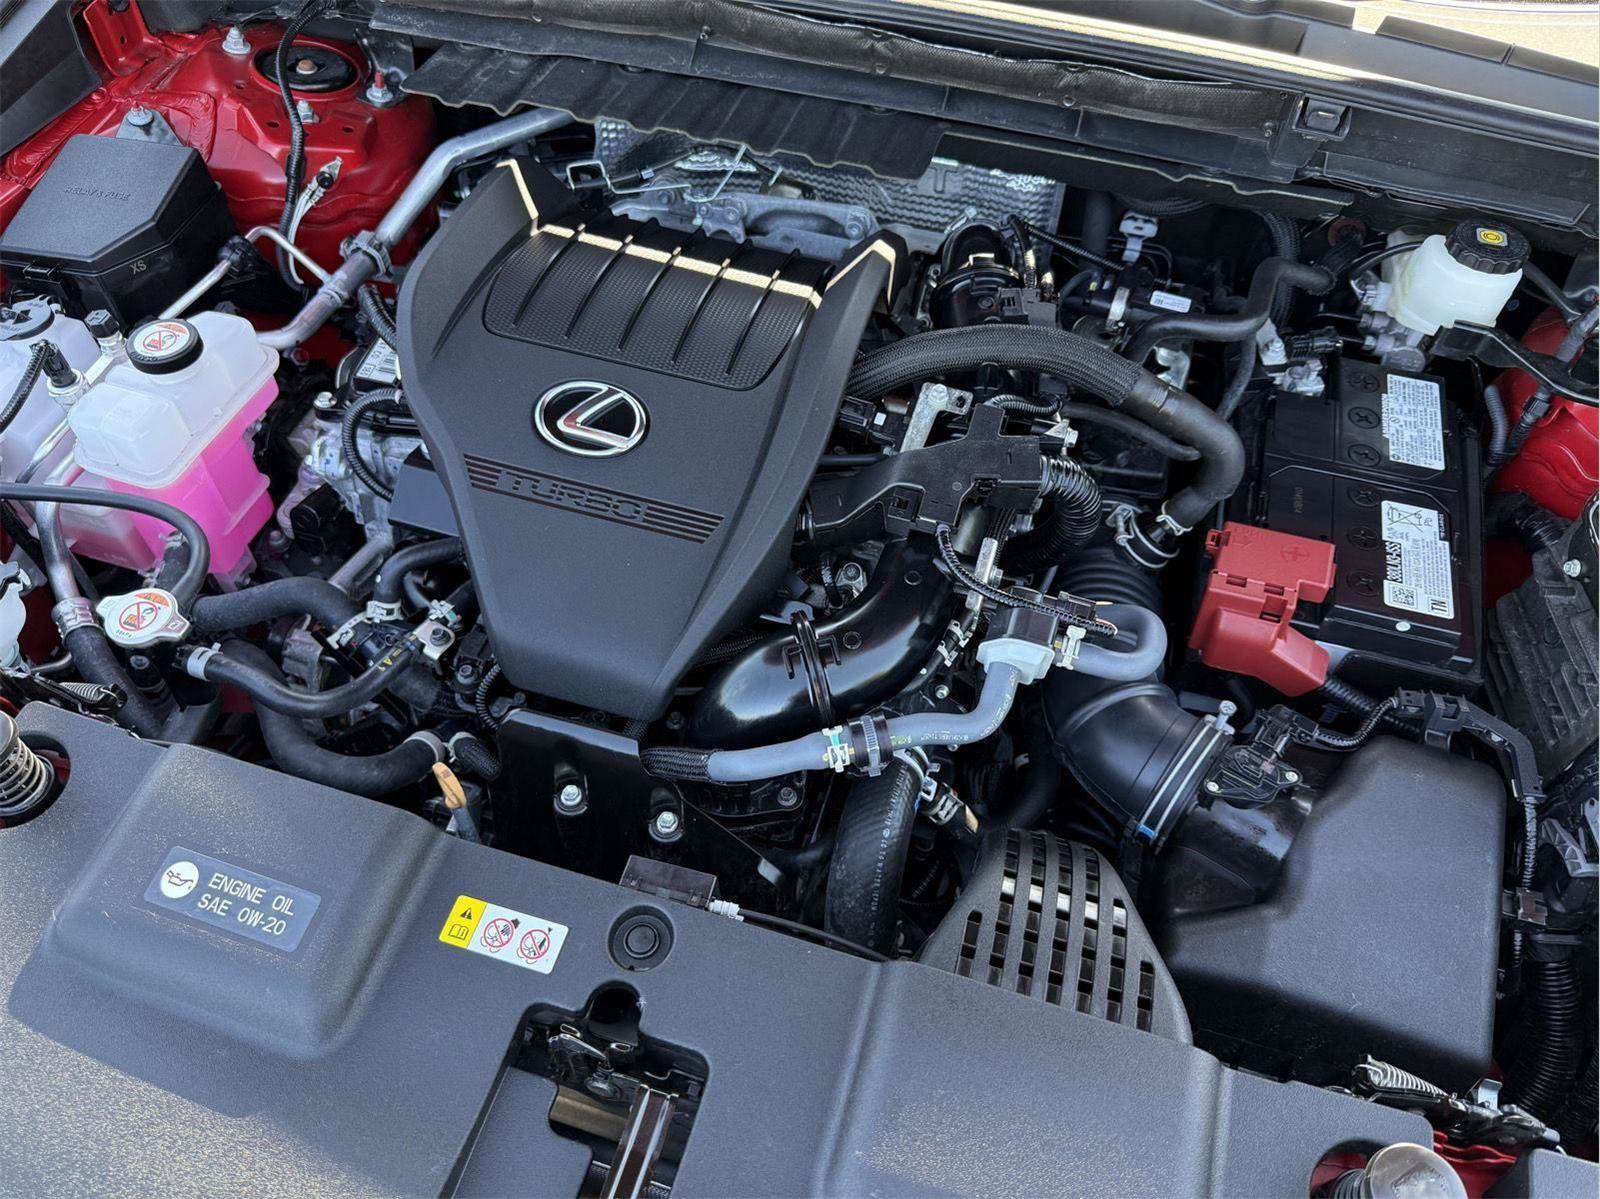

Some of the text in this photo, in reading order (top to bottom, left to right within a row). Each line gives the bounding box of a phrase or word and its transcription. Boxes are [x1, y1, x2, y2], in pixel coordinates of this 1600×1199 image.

[129, 260, 147, 275] XS
[496, 471, 648, 522] TURBO
[1430, 598, 1448, 612] TN
[197, 893, 287, 936] SAE 0W-20
[208, 872, 295, 916] ENGINE OIL
